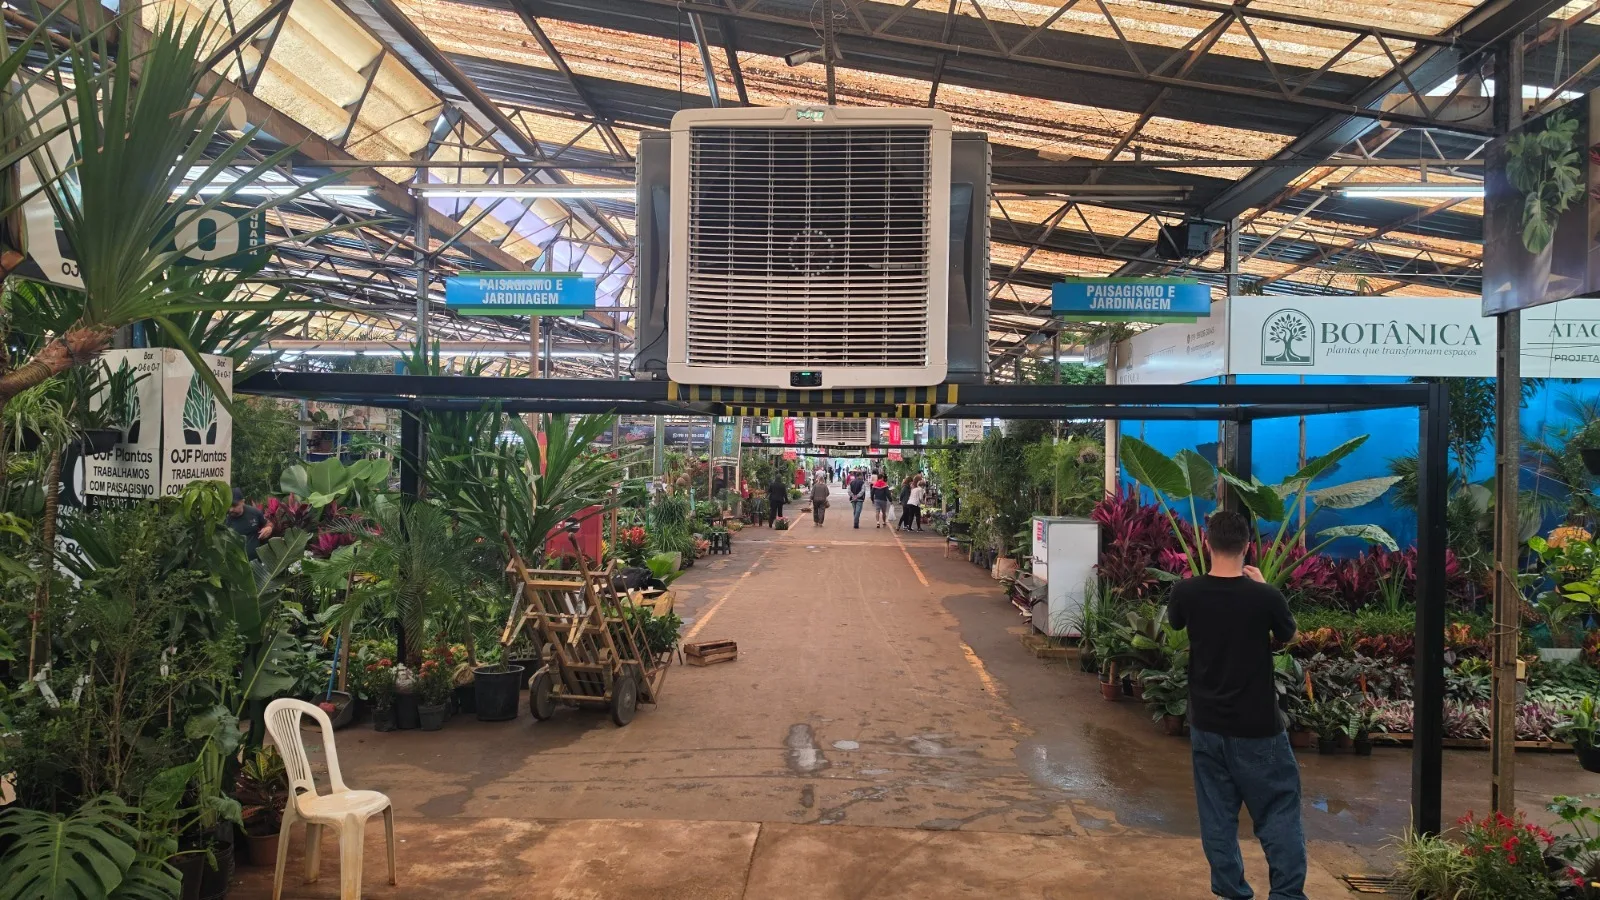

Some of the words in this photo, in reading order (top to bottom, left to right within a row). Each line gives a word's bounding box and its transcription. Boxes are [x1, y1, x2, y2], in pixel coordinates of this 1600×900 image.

[174, 209, 240, 261] O
[249, 213, 258, 256] QUADR
[61, 262, 80, 277] OJ
[479, 278, 552, 291] PAISAGISMO
[556, 279, 563, 291] E
[482, 292, 559, 304] JARDINAGEM
[1086, 285, 1163, 297] PAISAGISMO
[1168, 286, 1176, 298] E
[1089, 298, 1171, 310] JARDINAGEM
[1320, 320, 1482, 346] BOTÂNICA
[143, 351, 154, 360] Box
[1326, 346, 1361, 356] plantas
[1362, 348, 1380, 357] que
[1382, 346, 1442, 357] transformam
[216, 359, 226, 368] Box
[115, 447, 153, 464] Plantas
[170, 449, 192, 464] OJF
[194, 449, 227, 463] Plantas
[93, 466, 150, 479] TRABALHAMOS
[172, 467, 224, 480] TRABALHAMOS
[89, 481, 105, 491] COM
[106, 482, 154, 496] PAISAGISMO
